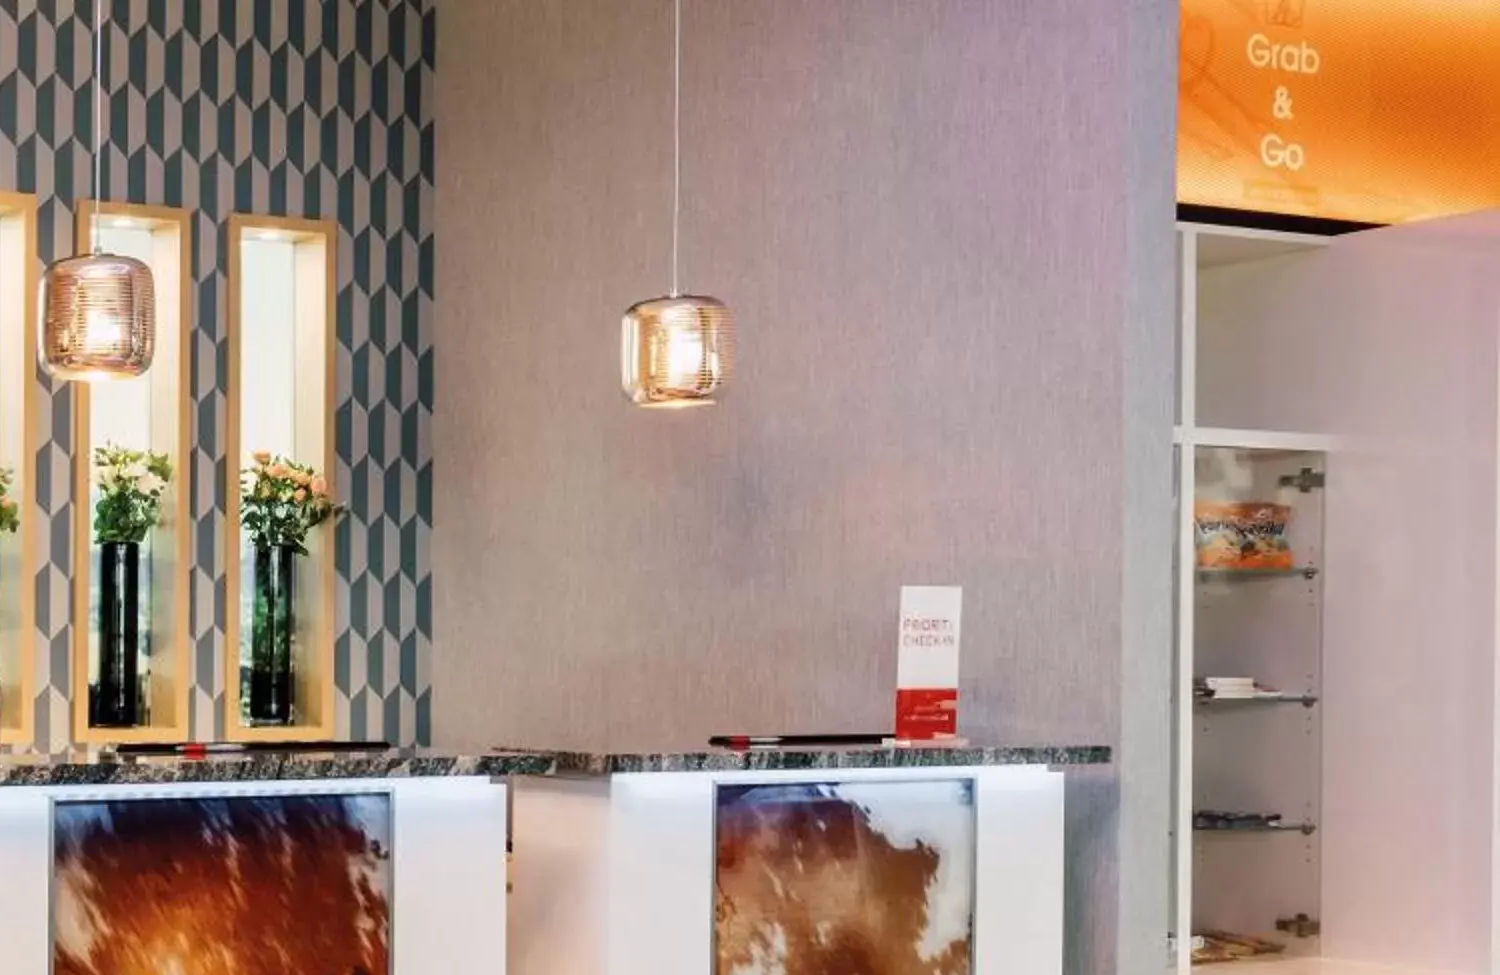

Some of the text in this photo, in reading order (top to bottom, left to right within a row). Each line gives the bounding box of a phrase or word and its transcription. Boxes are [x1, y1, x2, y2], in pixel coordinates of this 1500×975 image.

[1246, 33, 1320, 74] Grab
[1273, 85, 1294, 119] &
[1260, 133, 1304, 170] Go
